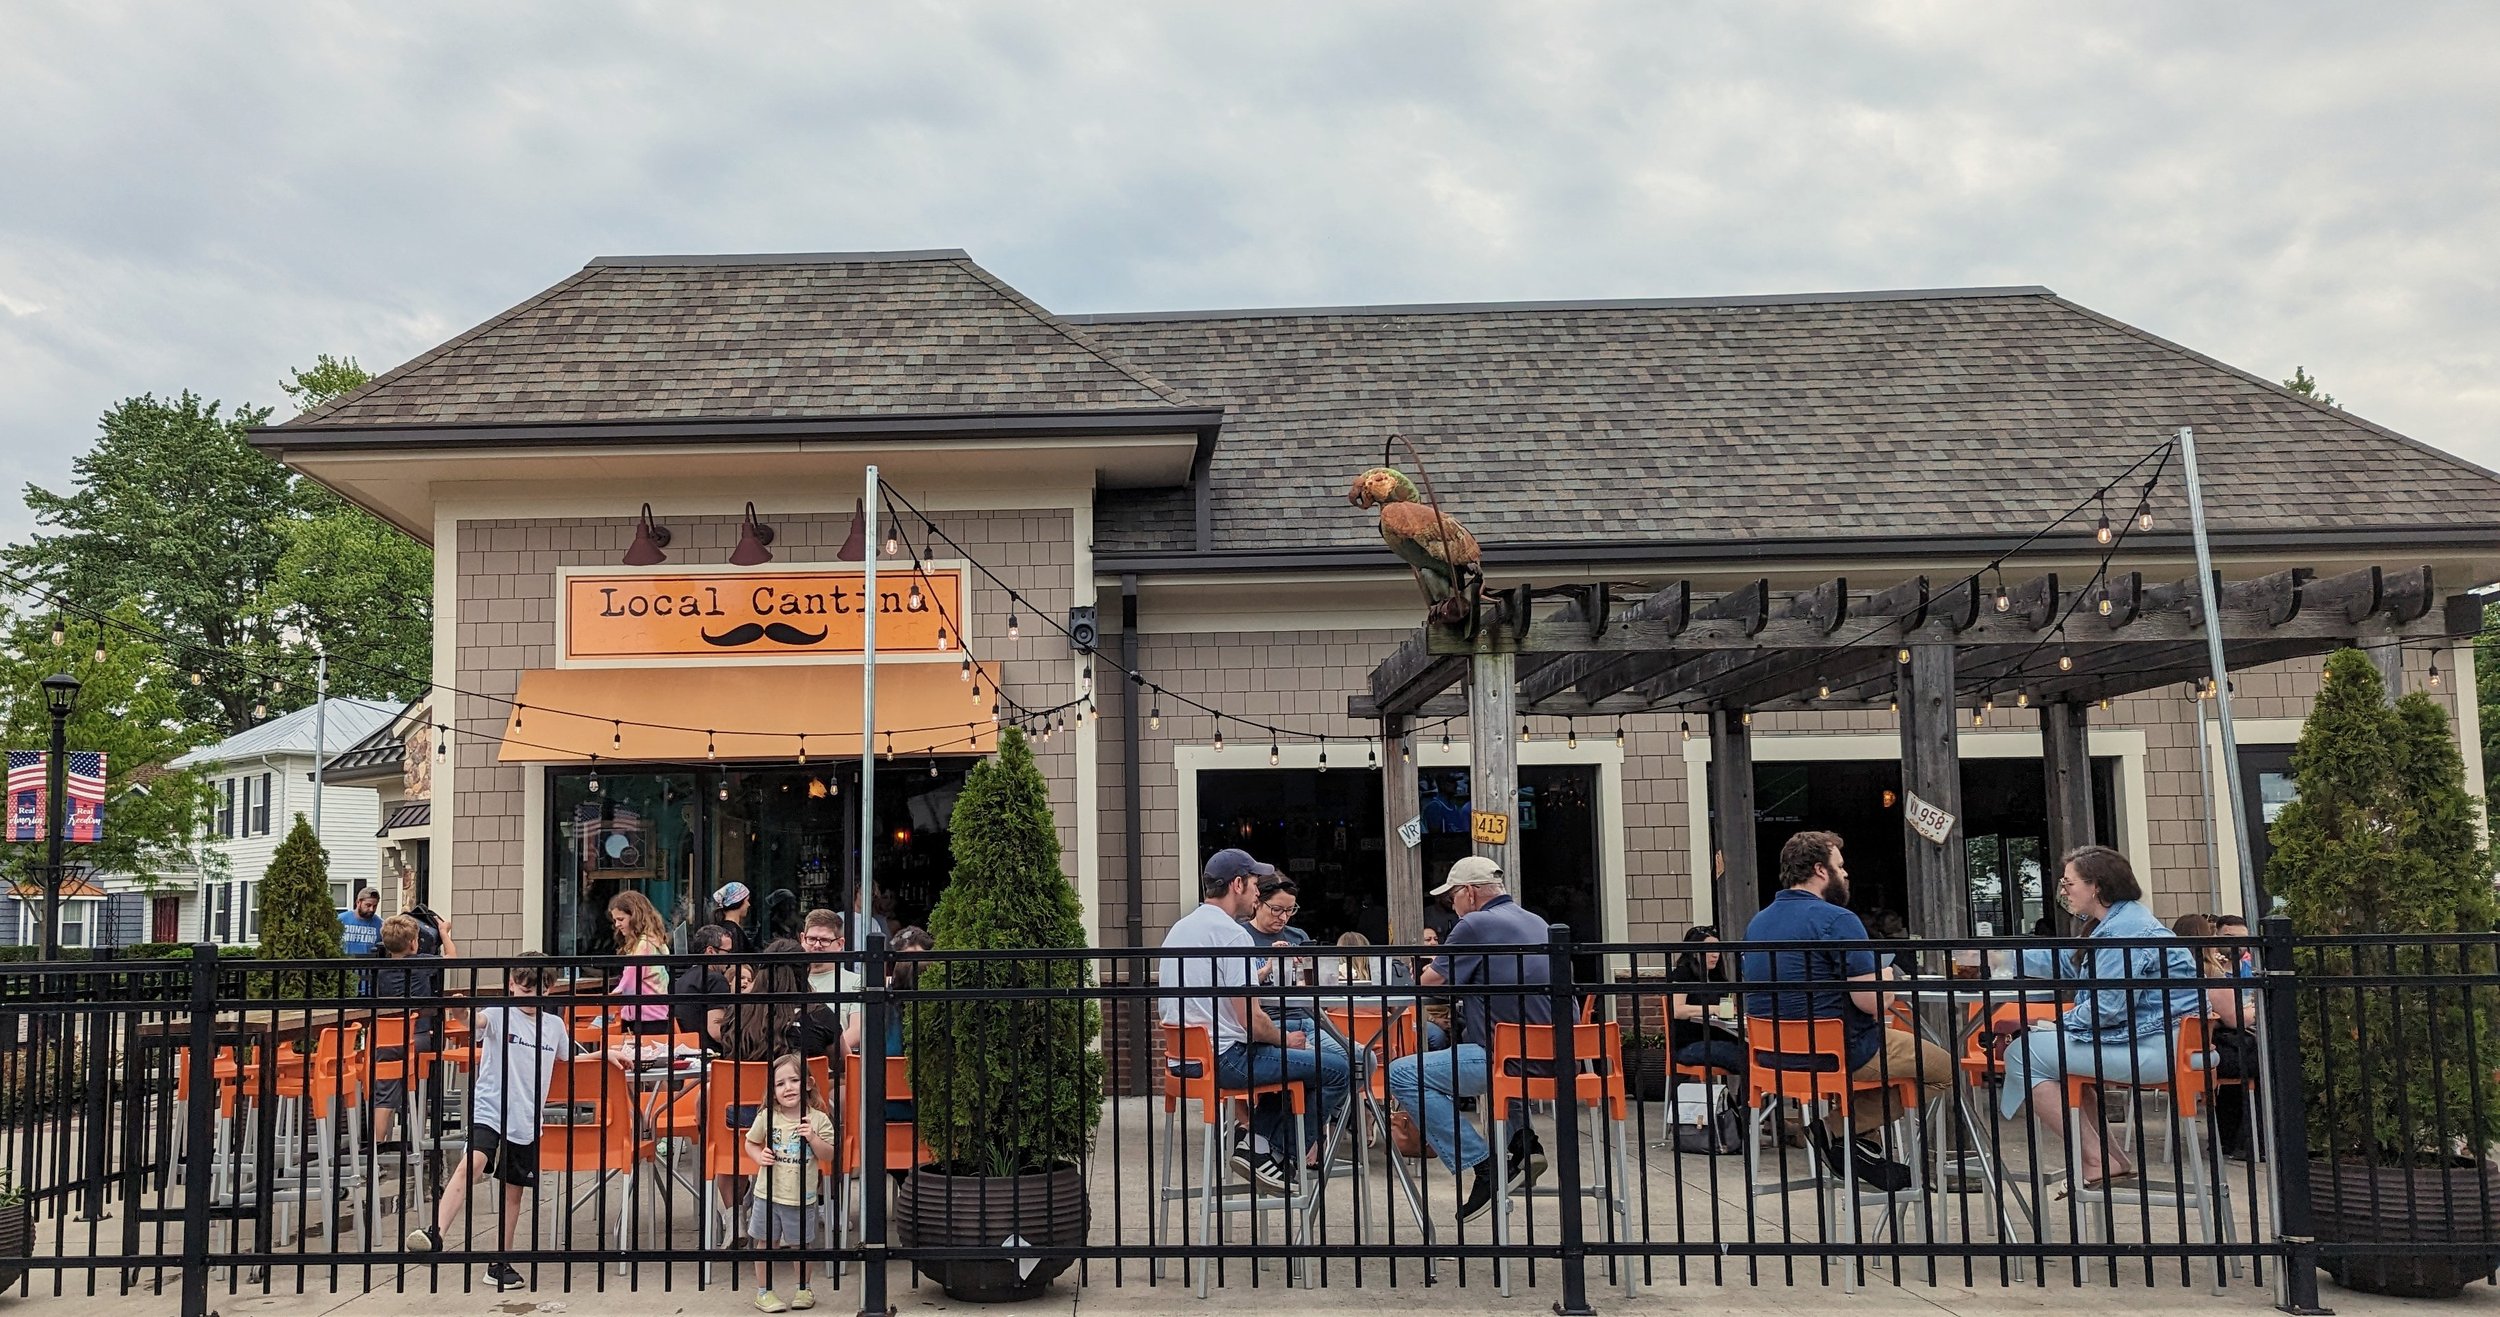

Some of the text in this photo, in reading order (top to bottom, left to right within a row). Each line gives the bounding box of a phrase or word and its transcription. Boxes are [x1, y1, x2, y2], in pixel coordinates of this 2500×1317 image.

[599, 587, 725, 616] Local
[9, 813, 43, 826] America
[67, 813, 101, 826] Freedom
